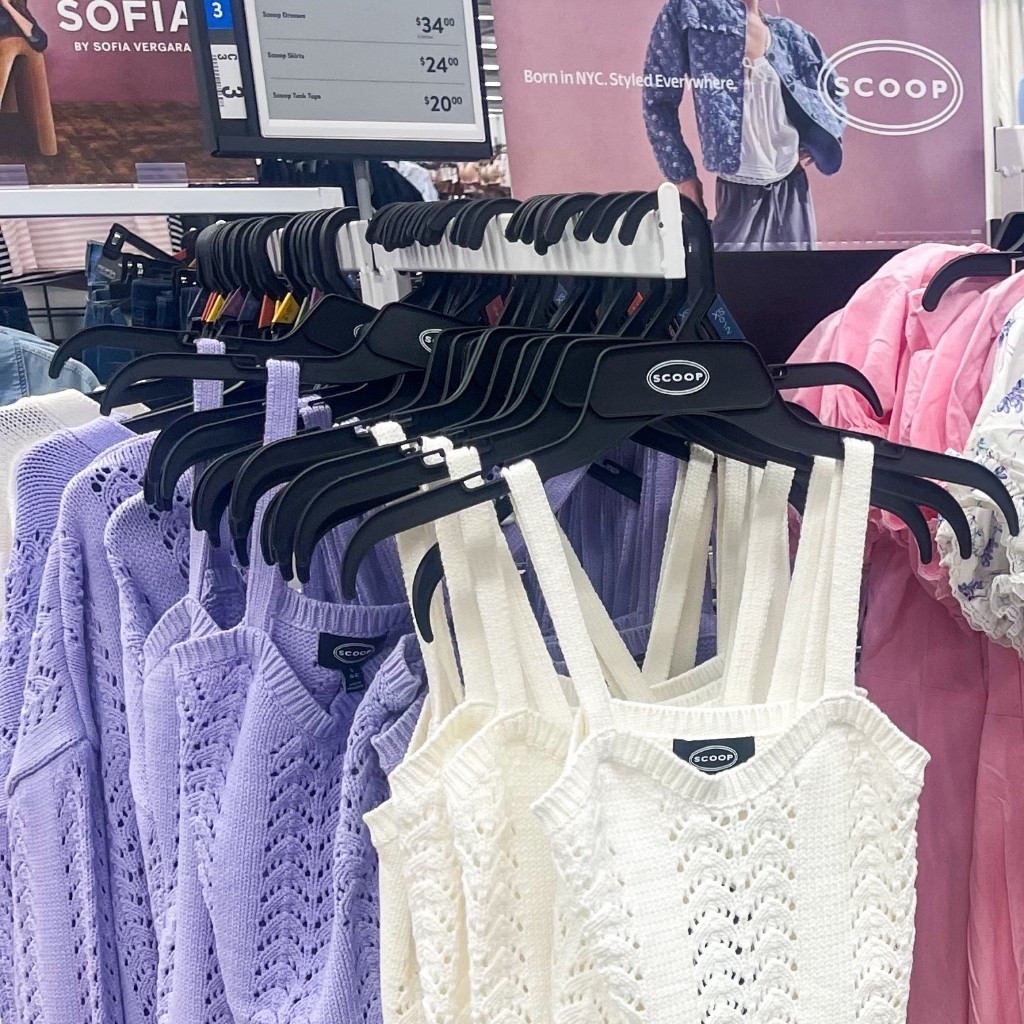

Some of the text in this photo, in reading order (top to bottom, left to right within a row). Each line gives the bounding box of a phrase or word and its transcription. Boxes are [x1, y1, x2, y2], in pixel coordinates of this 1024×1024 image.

[56, 0, 189, 32] SOFIA
[211, 2, 223, 18] 3
[74, 41, 192, 52] BY SOFIA VERGARA
[523, 69, 739, 91] Born in NYC. Styled Everywhere.
[833, 76, 948, 100] SCOOP
[652, 372, 704, 383] SCOOP
[694, 754, 734, 763] SCOOP
